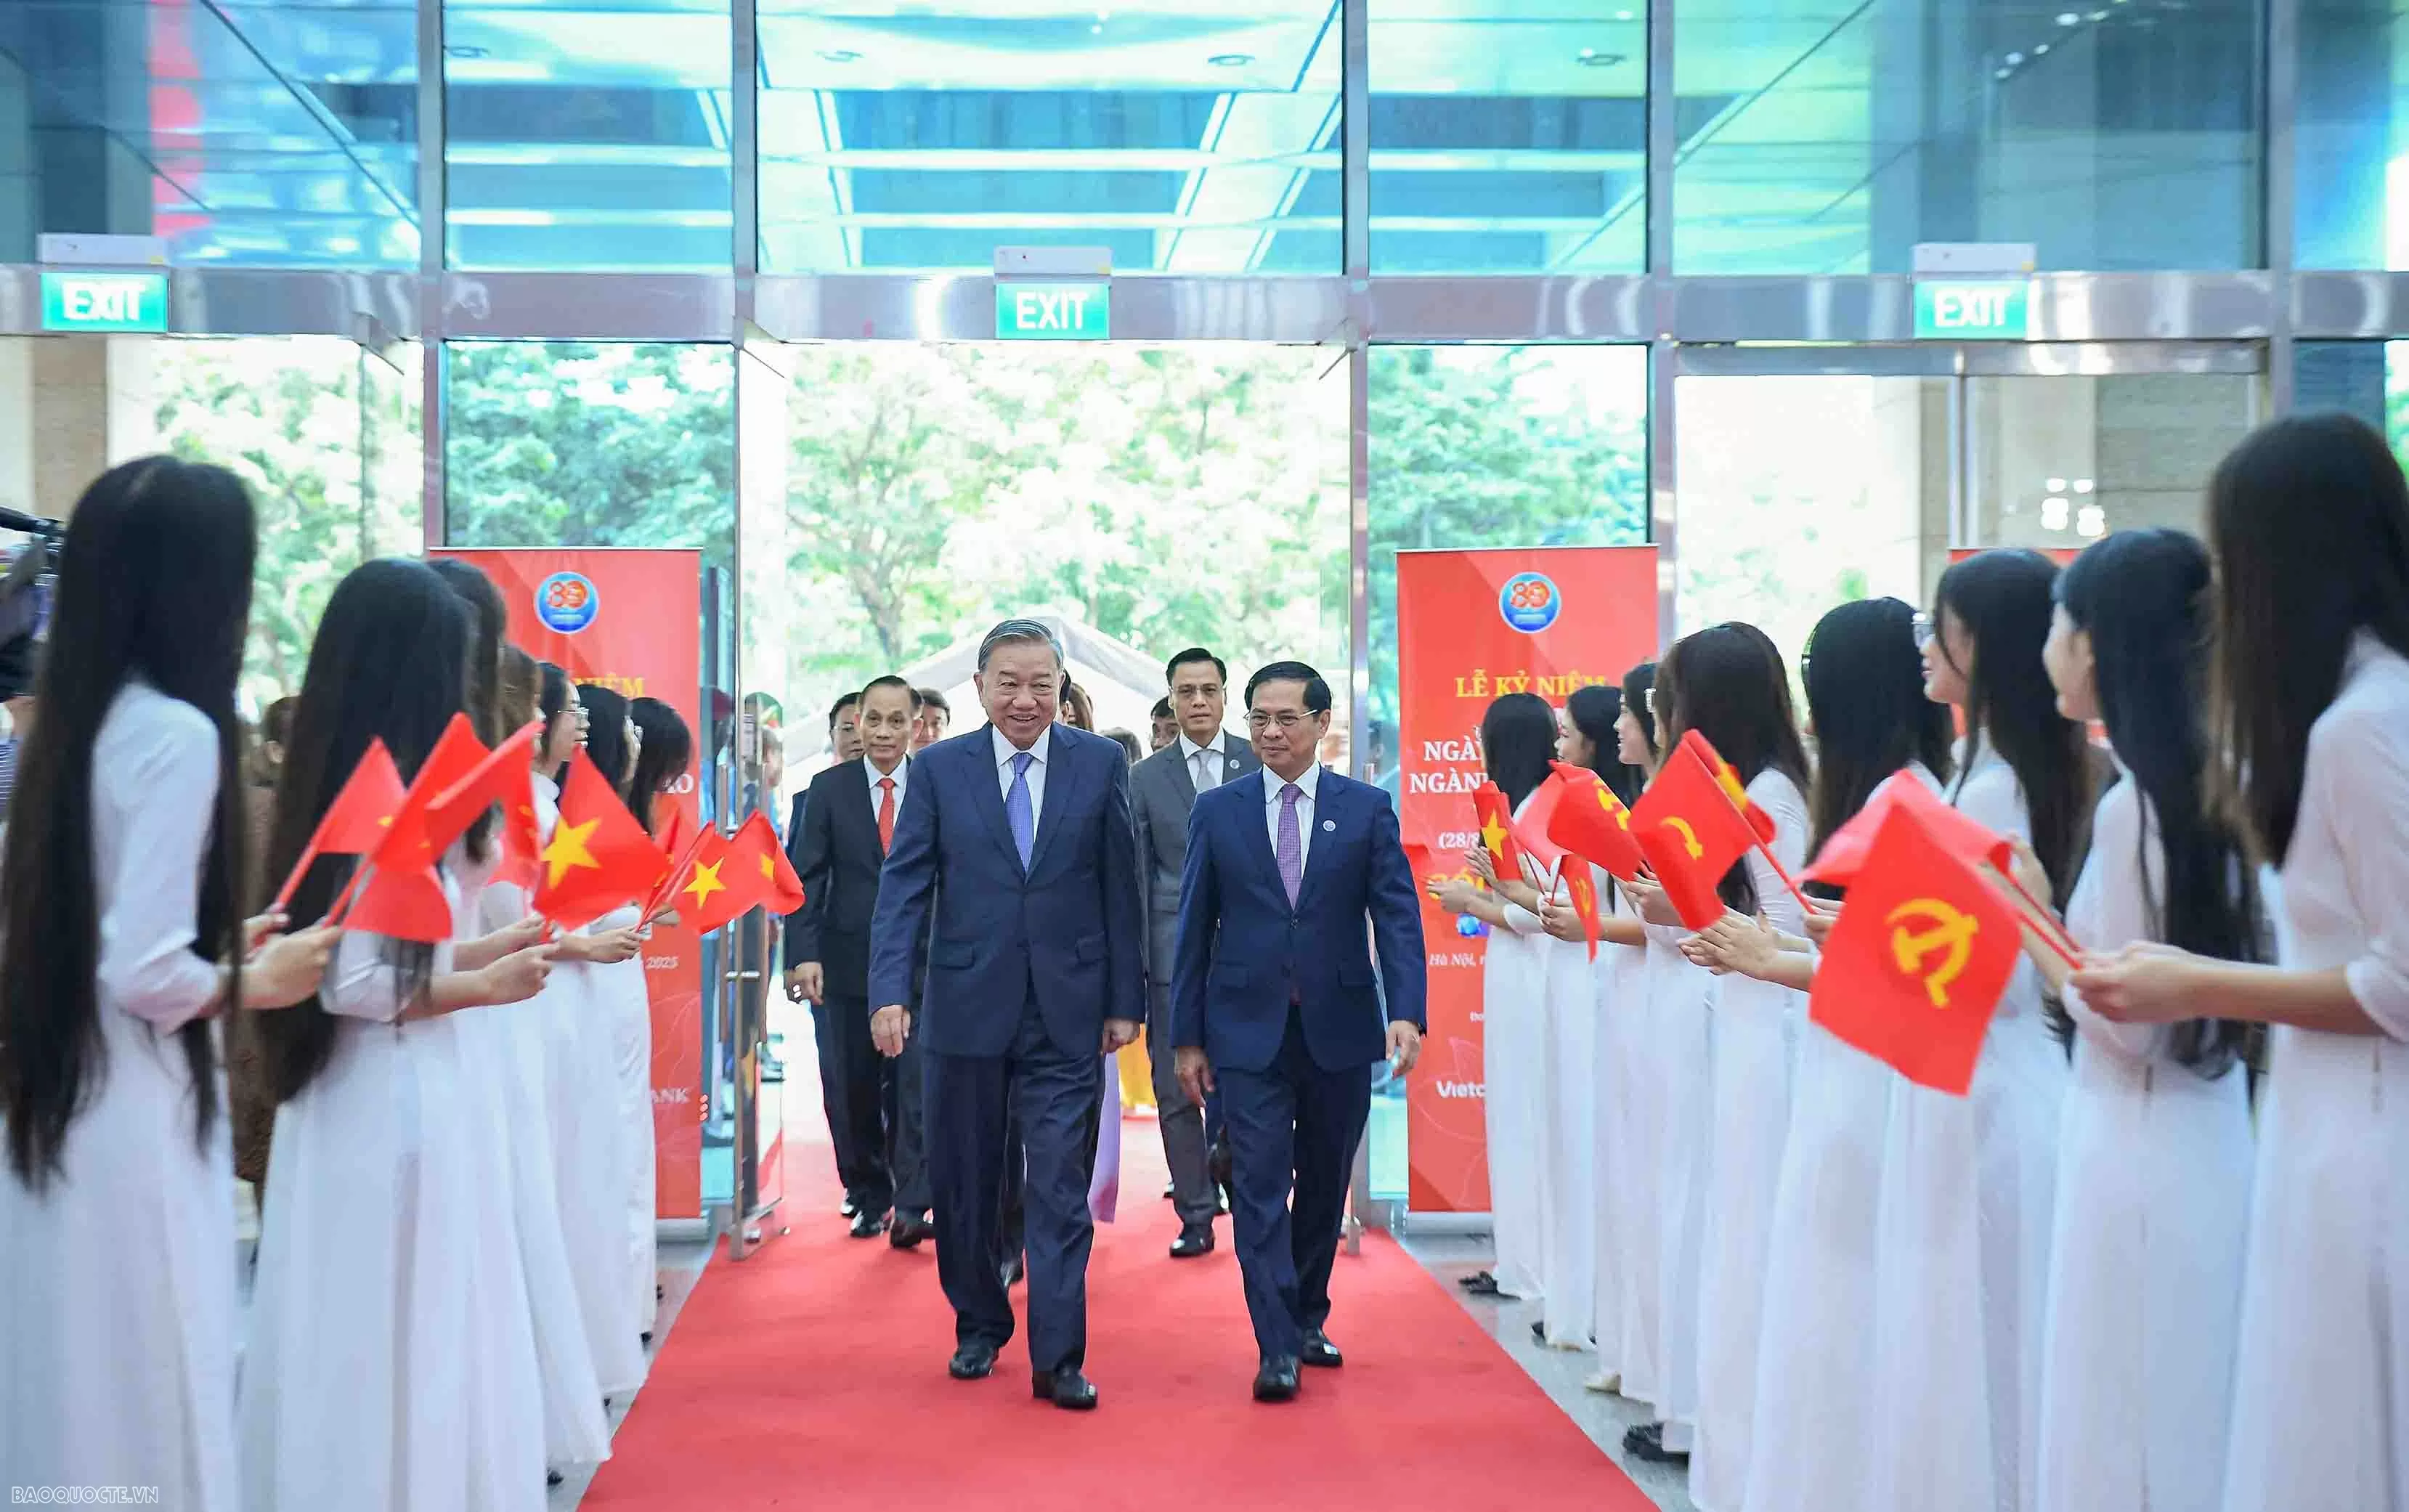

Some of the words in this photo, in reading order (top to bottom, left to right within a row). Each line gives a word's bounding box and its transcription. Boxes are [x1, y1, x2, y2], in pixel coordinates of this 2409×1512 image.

[62, 280, 149, 321] EXIT
[1016, 290, 1087, 330] EXIT
[1934, 289, 2011, 327] EXIT
[1455, 668, 1489, 698] LỄ
[1494, 670, 1530, 697] KỶ
